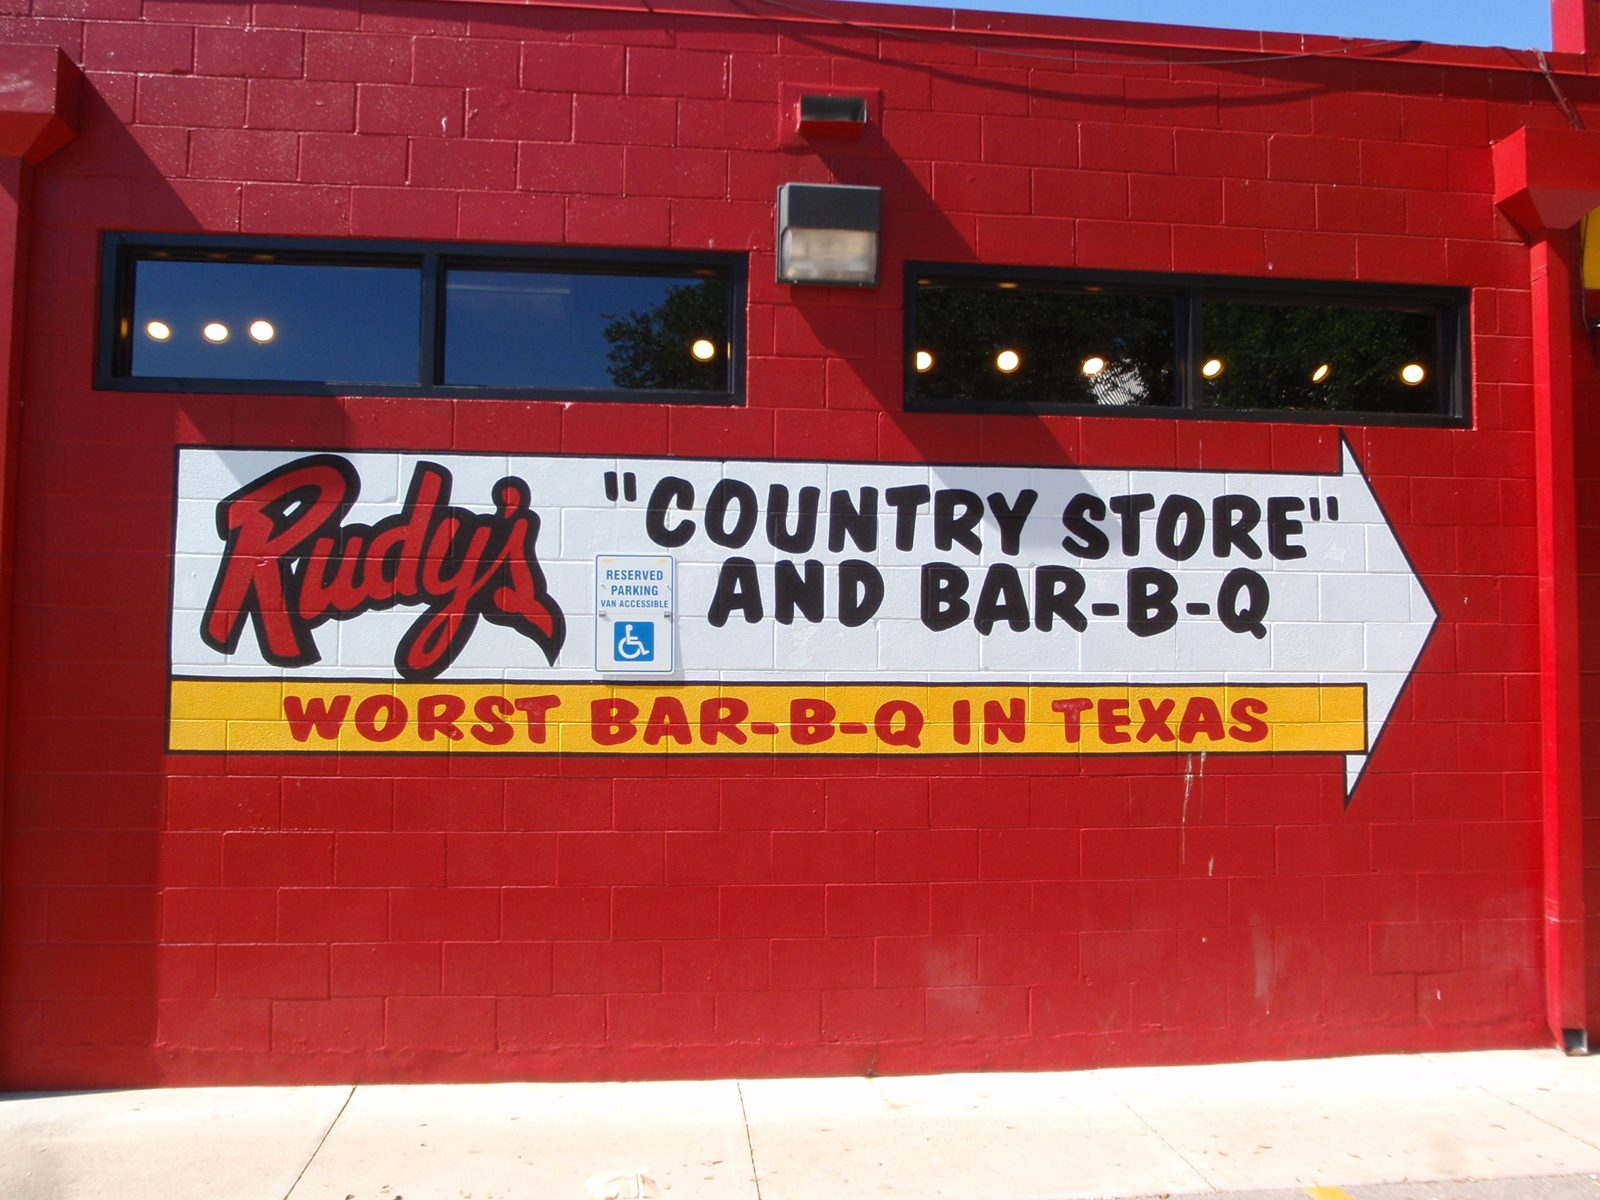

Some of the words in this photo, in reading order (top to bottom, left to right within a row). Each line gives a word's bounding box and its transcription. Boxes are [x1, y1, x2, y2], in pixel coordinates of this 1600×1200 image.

[603, 471, 1038, 555] "COUNTRY
[1062, 493, 1340, 560] STORE"
[200, 454, 566, 680] Rudy's
[606, 569, 664, 581] RESERVED
[611, 585, 659, 596] PARKING
[600, 599, 617, 608] VAN
[619, 599, 669, 609] ACCESSIBLE
[707, 556, 885, 628] AND
[920, 563, 1270, 640] BAR-B-Q
[283, 694, 562, 746] WORST
[590, 696, 925, 748] BAR-B-Q
[953, 698, 1026, 746] IN
[1051, 696, 1270, 745] TEXAS
